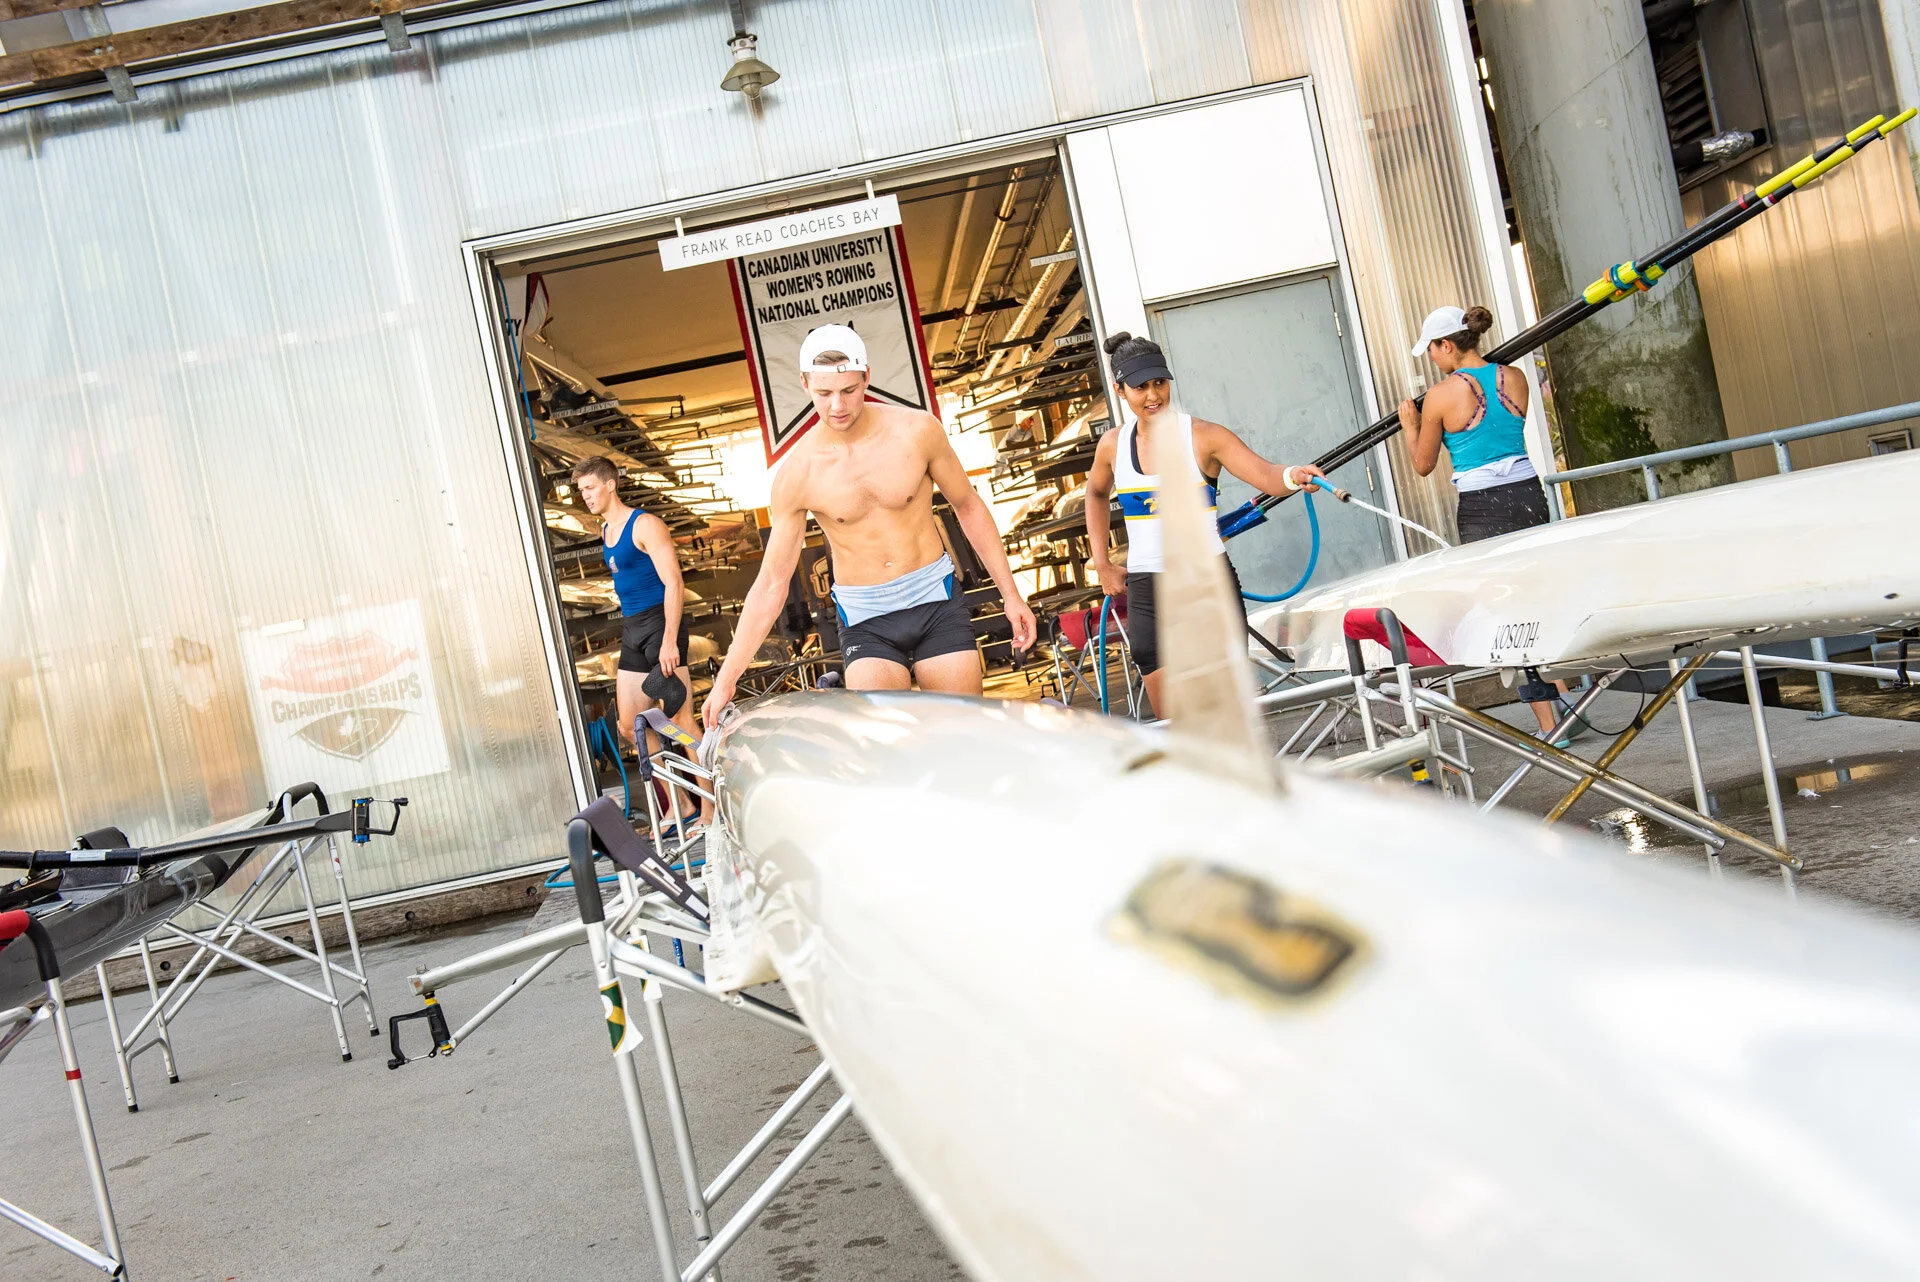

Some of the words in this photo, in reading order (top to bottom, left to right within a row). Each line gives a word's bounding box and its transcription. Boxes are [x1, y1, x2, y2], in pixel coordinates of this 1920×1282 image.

[682, 238, 728, 258] FRANK
[736, 229, 773, 247] READ
[780, 214, 846, 239] COACHES
[852, 207, 879, 224] BAY
[748, 250, 810, 279] CANADIAN
[811, 234, 883, 266] UNIVERSITY
[766, 271, 824, 299] WOMEN'S
[826, 261, 876, 287] ROWING
[758, 297, 820, 324] NATIONAL
[822, 281, 894, 312] CHAMPIONS
[1491, 621, 1540, 650] HUDSON
[270, 671, 423, 724] CHAMPIONSHIPS
